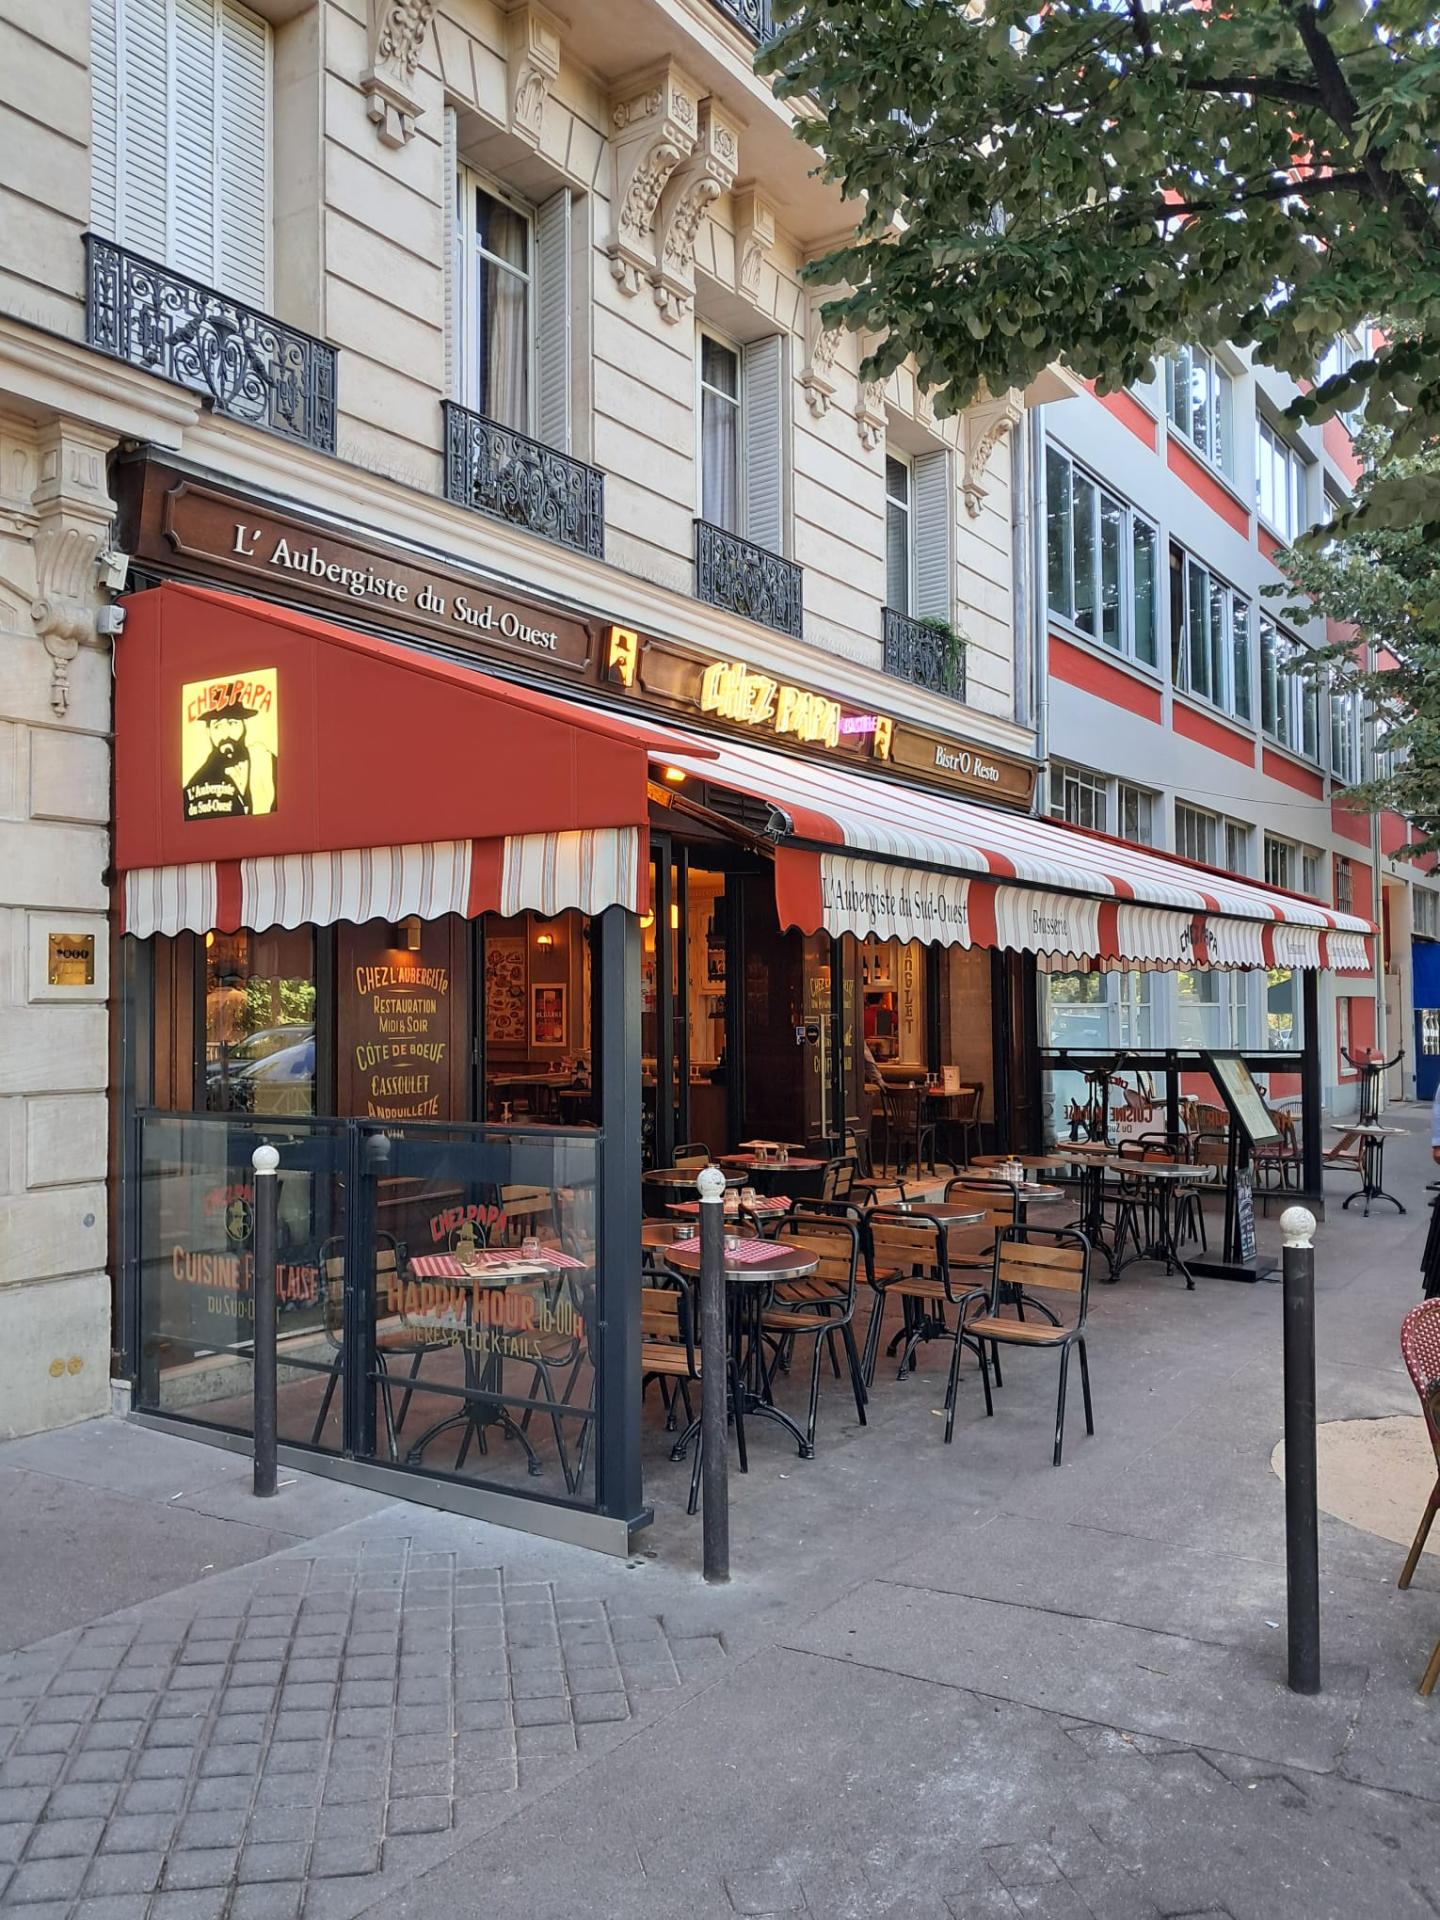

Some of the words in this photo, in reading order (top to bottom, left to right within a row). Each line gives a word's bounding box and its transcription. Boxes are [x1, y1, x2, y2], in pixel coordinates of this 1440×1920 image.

[269, 538, 408, 602] Aubergiste
[416, 585, 445, 615] du
[454, 597, 558, 650] Sud-Ouest
[187, 682, 229, 723] CHEZ
[229, 680, 272, 713] PAPA
[701, 662, 777, 725] CHEZ
[775, 686, 841, 749] PAPA
[973, 757, 999, 782] Resto
[186, 781, 235, 801] L'Aubergiste
[188, 802, 198, 816] du
[198, 799, 232, 814] Sud-Ouest
[822, 877, 896, 925] L'Aubergiste
[898, 888, 912, 918] du
[914, 890, 967, 925] Sud-Ouest
[1032, 910, 1069, 936] Brasserie
[356, 966, 388, 995] CHEZ
[373, 995, 437, 1014] RESTAURATION
[407, 1016, 428, 1033] SOIR
[356, 1042, 390, 1072] CÔTE
[392, 1044, 407, 1057] DE
[410, 1043, 446, 1065] BOEUF
[371, 1074, 430, 1097] CASSOULET
[367, 1094, 440, 1120] ANDOUILLETTE
[430, 1205, 465, 1242] CHEZ
[466, 1204, 507, 1233] PAPA
[172, 1245, 241, 1291] CUISINE
[387, 1276, 466, 1322] HAPPY
[472, 1280, 535, 1331] HOUR
